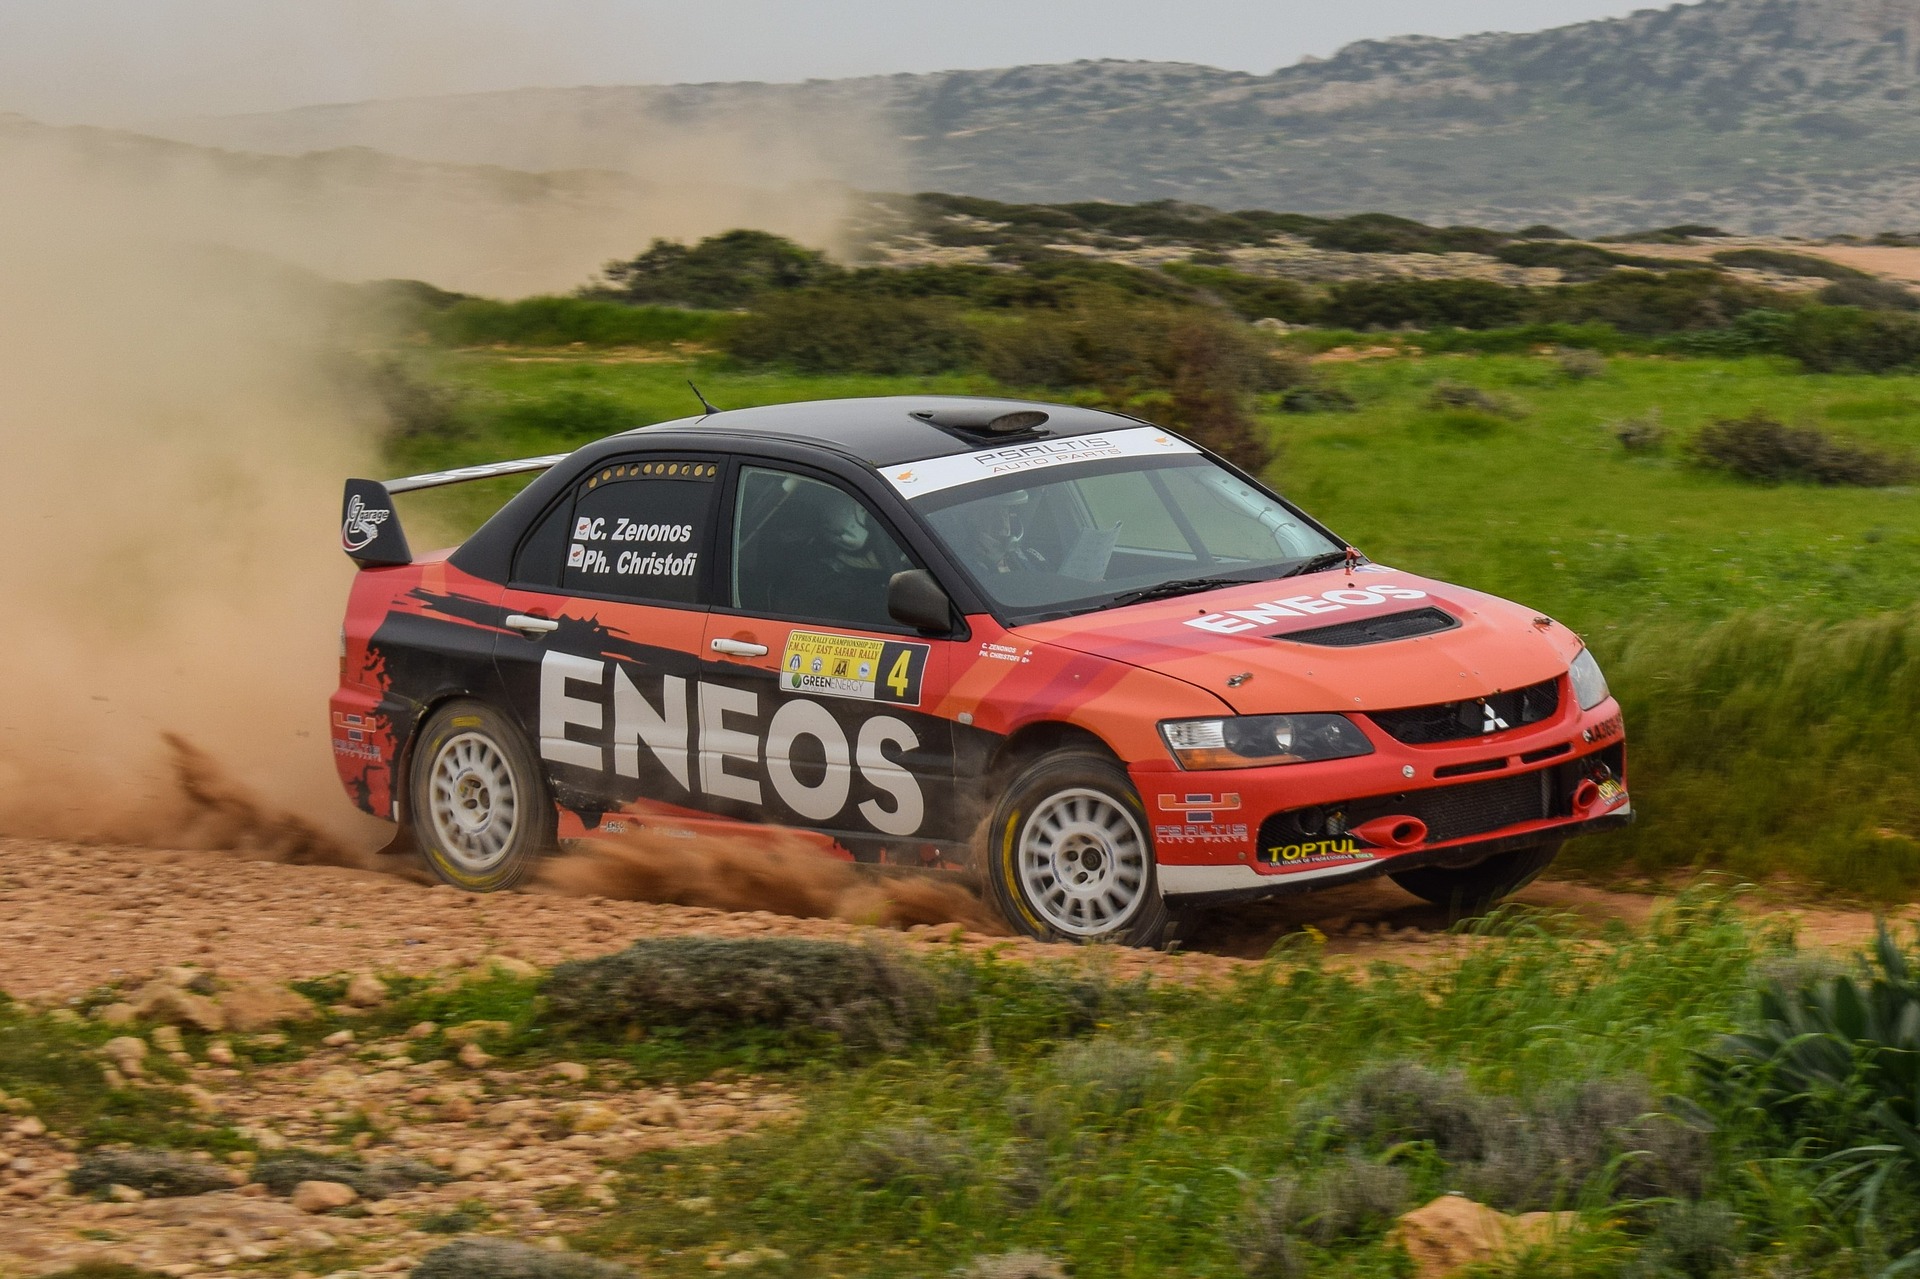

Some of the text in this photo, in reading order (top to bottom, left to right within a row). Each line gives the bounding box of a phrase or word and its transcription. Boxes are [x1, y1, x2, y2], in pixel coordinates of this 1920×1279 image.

[974, 438, 1112, 465] PSALTIS
[993, 449, 1122, 473] AUTO PARTS
[406, 454, 573, 482] NEOS
[589, 517, 692, 542] C. Zenonos
[581, 550, 698, 576] Ph. Christofi
[1182, 585, 1427, 634] ENEOS
[792, 634, 811, 642] CYPRUS
[811, 635, 828, 644] RALLY
[828, 638, 868, 649] CHAMPIONSHIP
[816, 645, 833, 655] EAST
[833, 647, 857, 658] SAFARI
[858, 650, 880, 660] RALLY
[887, 650, 912, 697] 4
[539, 649, 924, 836] ENEOS
[1155, 823, 1248, 837] PSALTIS
[1267, 839, 1361, 863] TOPTUL
